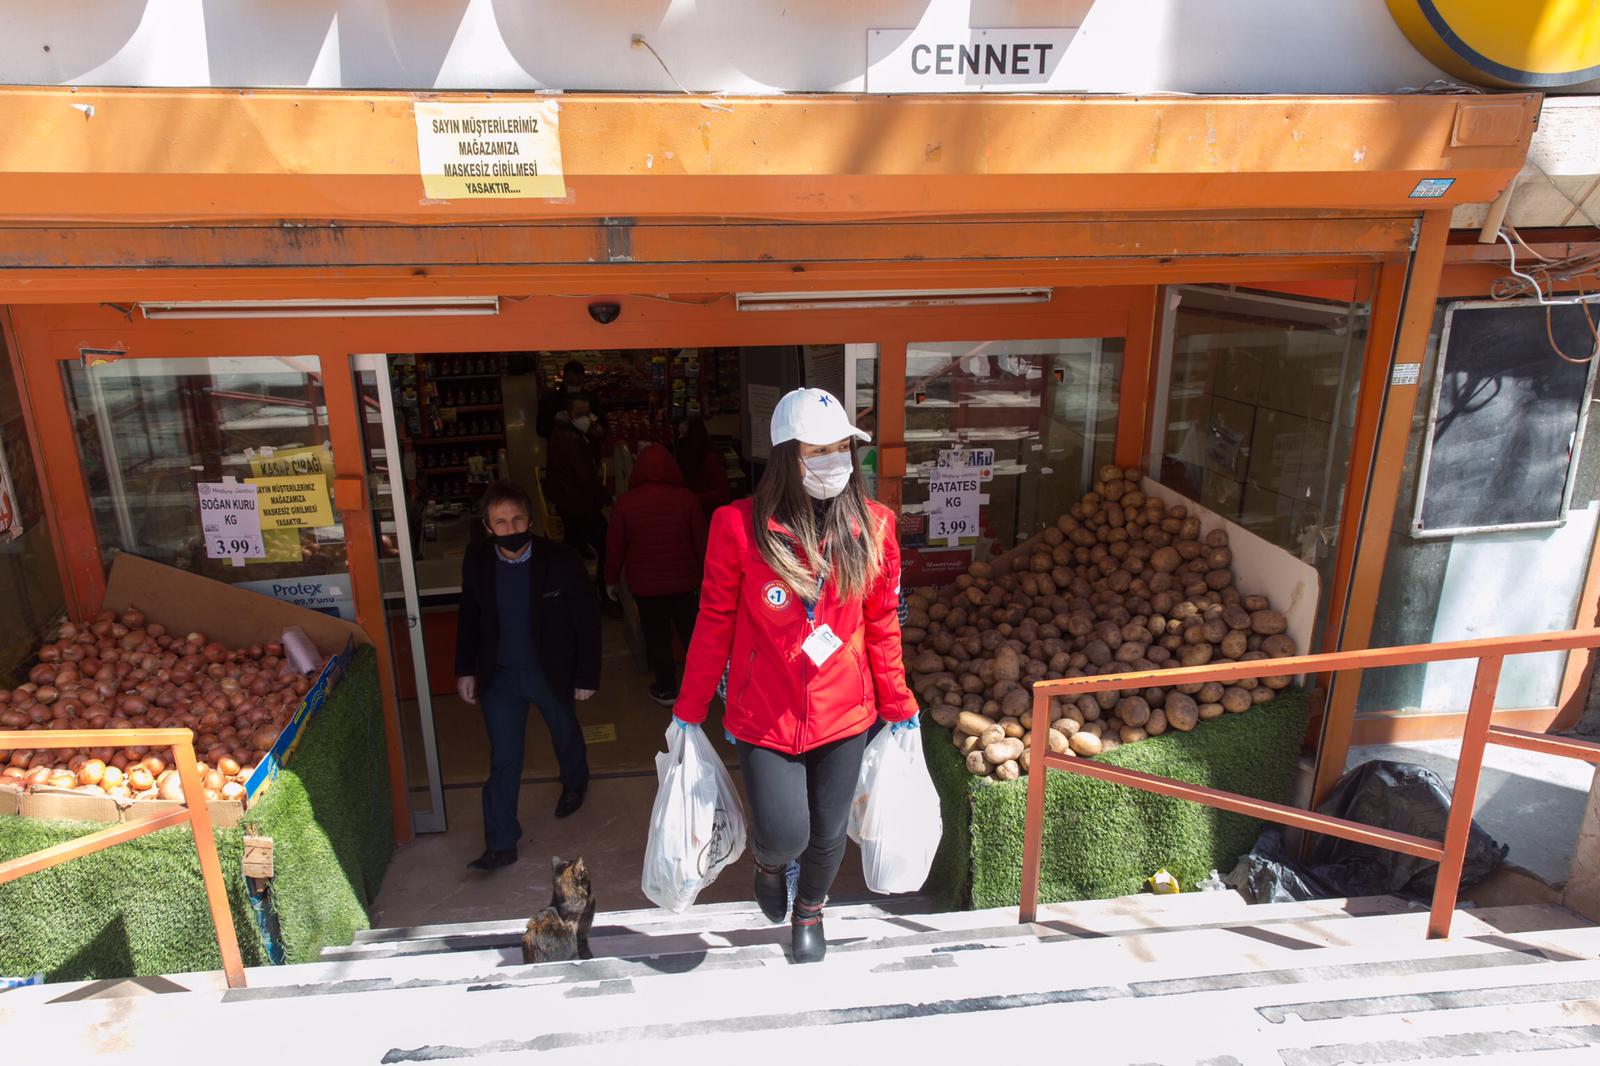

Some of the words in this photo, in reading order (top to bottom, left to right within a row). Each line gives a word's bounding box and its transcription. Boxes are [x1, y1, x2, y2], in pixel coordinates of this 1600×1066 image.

[911, 44, 1053, 75] CENNET
[432, 119, 460, 134] SAYIN
[462, 116, 539, 137] MÜŞTERİLERİMİZ
[458, 139, 520, 156] MAĞAZAMIZA
[444, 160, 491, 177] MASKESİZ
[492, 160, 538, 177] GİRİLMESİ
[931, 481, 977, 493] PATATES
[202, 497, 232, 510] SOĞAN
[233, 500, 255, 510] KURU
[945, 497, 961, 507] KG
[225, 515, 237, 525] KG
[938, 520, 967, 535] 3.99
[216, 540, 249, 554] 3.99
[272, 583, 322, 597] Protex
